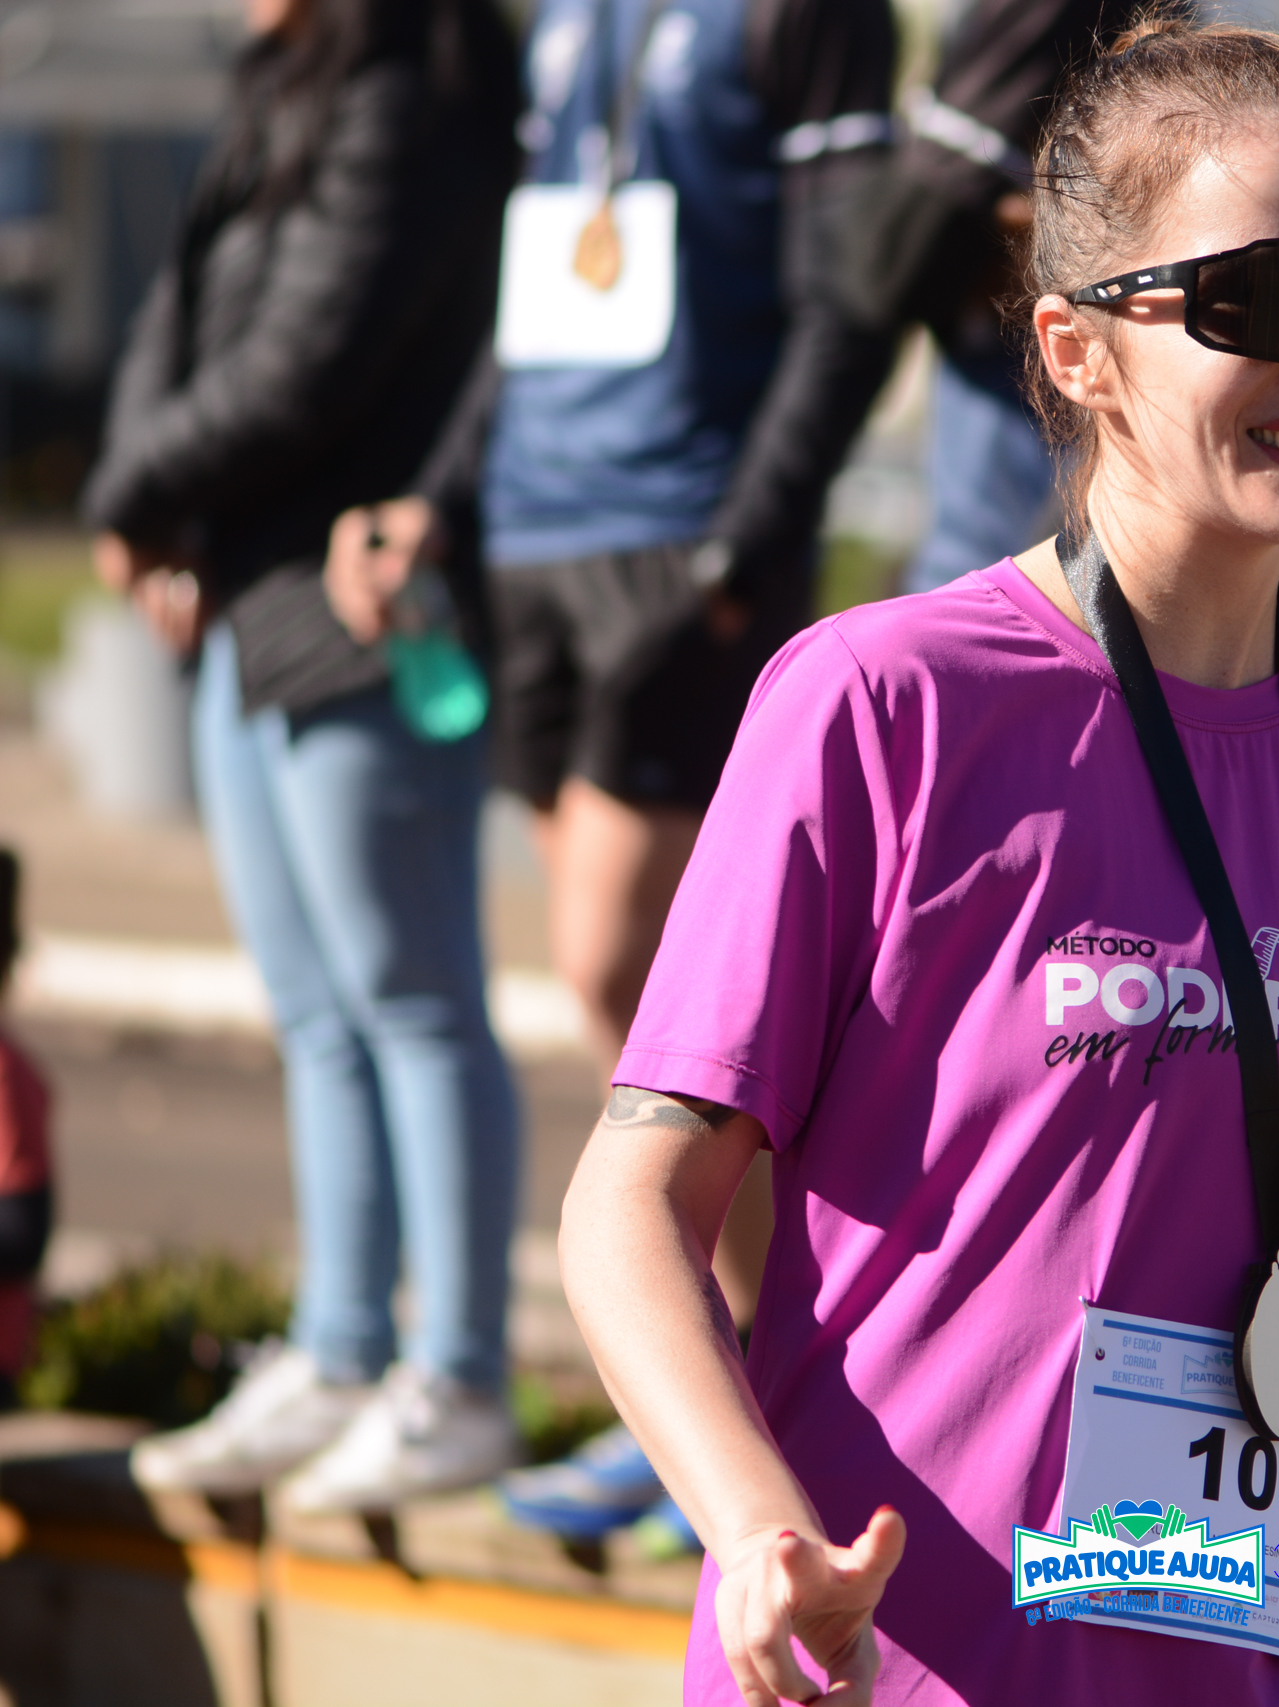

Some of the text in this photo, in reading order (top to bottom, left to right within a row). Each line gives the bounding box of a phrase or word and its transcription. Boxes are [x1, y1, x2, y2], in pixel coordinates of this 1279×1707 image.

[1046, 931, 1156, 958] MÉTODO
[1044, 1026, 1130, 1067] em
[1133, 1337, 1162, 1354] EDIÇÃO
[1123, 1354, 1157, 1370] CORRIDA
[1112, 1370, 1165, 1390] BENEFICENTE
[1186, 1372, 1235, 1386] PRATIQUE
